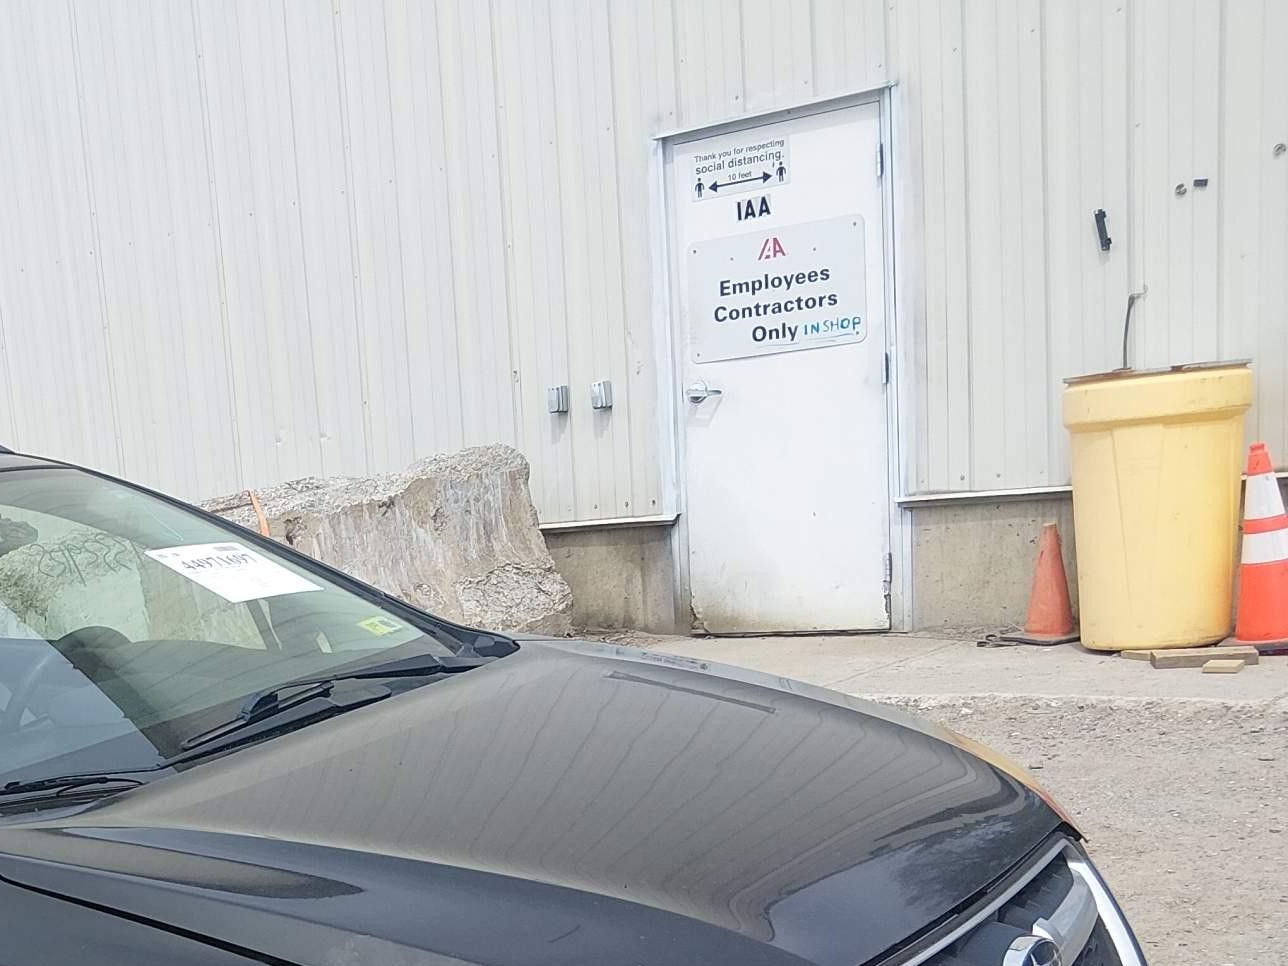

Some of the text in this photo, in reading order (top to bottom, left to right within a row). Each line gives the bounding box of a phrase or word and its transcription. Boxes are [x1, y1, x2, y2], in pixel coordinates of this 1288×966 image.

[694, 153, 716, 163] Thank
[718, 150, 731, 159] you
[745, 139, 785, 152] respecting
[695, 150, 785, 175] social distancing.
[728, 173, 737, 181] 10
[736, 196, 771, 221] IAA
[719, 268, 830, 297] Employees
[714, 293, 838, 322] Contractors
[752, 322, 798, 342] Only
